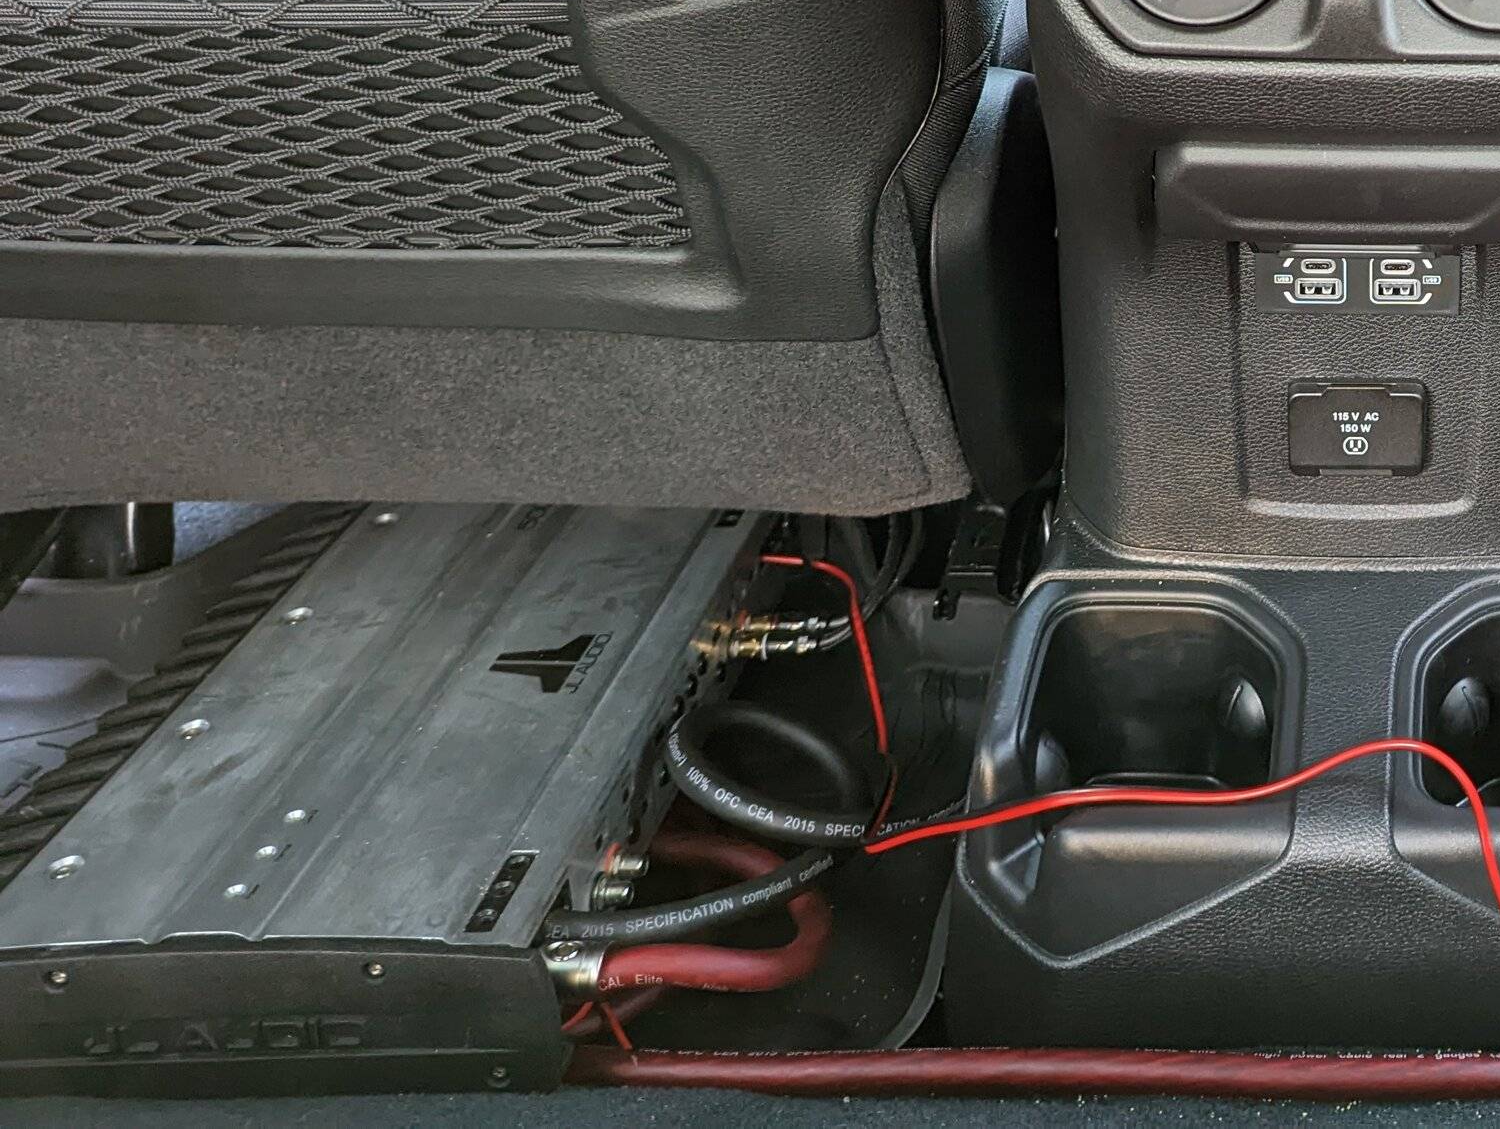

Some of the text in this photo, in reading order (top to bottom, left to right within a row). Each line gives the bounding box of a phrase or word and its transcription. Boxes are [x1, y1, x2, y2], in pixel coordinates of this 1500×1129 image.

[1332, 411, 1380, 422] 115 V AC
[1340, 423, 1372, 433] 150 W
[575, 630, 614, 676] AUDIO
[685, 766, 711, 792] 100%
[714, 788, 741, 809] OFC
[747, 803, 775, 824] CEA
[783, 815, 816, 833] 2015
[581, 923, 615, 939] 2015
[625, 897, 735, 935] SPECIFICATION
[742, 877, 793, 906] compliant
